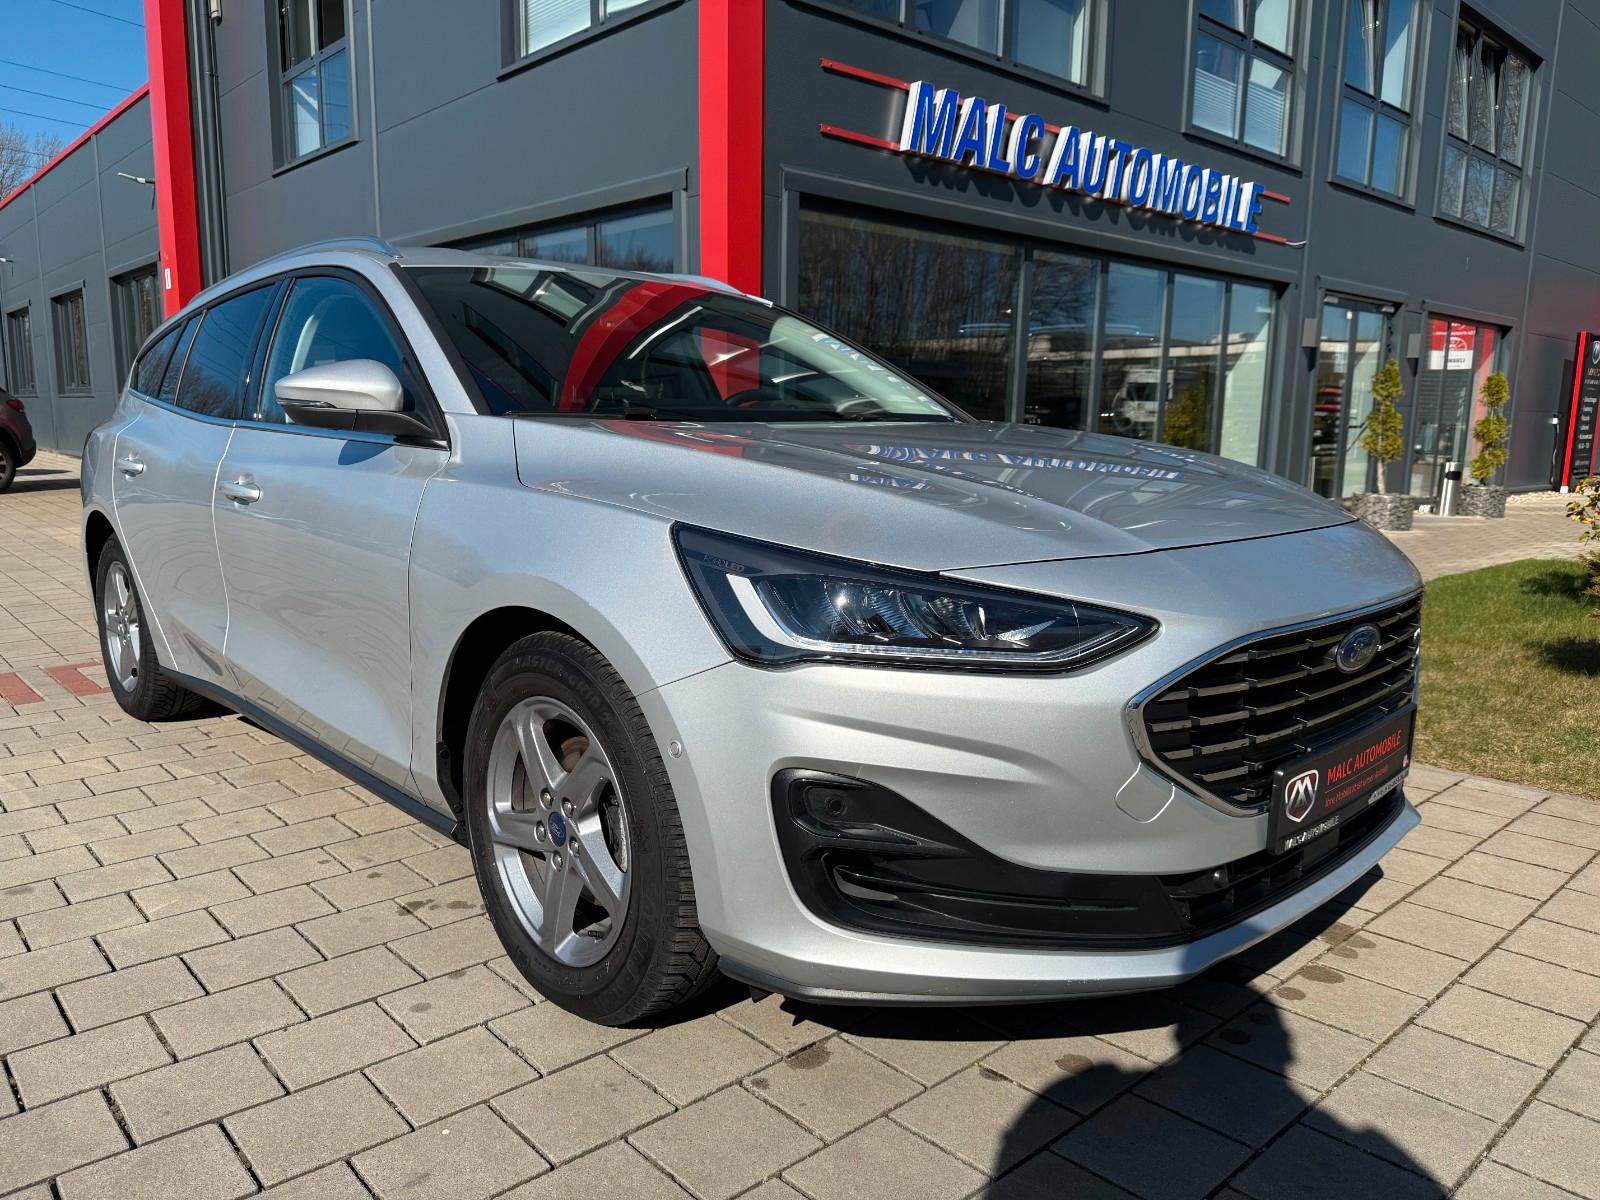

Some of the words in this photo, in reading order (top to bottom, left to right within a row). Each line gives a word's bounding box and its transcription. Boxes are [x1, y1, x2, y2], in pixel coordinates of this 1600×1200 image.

[900, 80, 1045, 179] MALC
[1043, 125, 1265, 233] AUTOMOBILE
[1327, 757, 1353, 785] MALC
[1353, 729, 1402, 771] AUTOMOBILE
